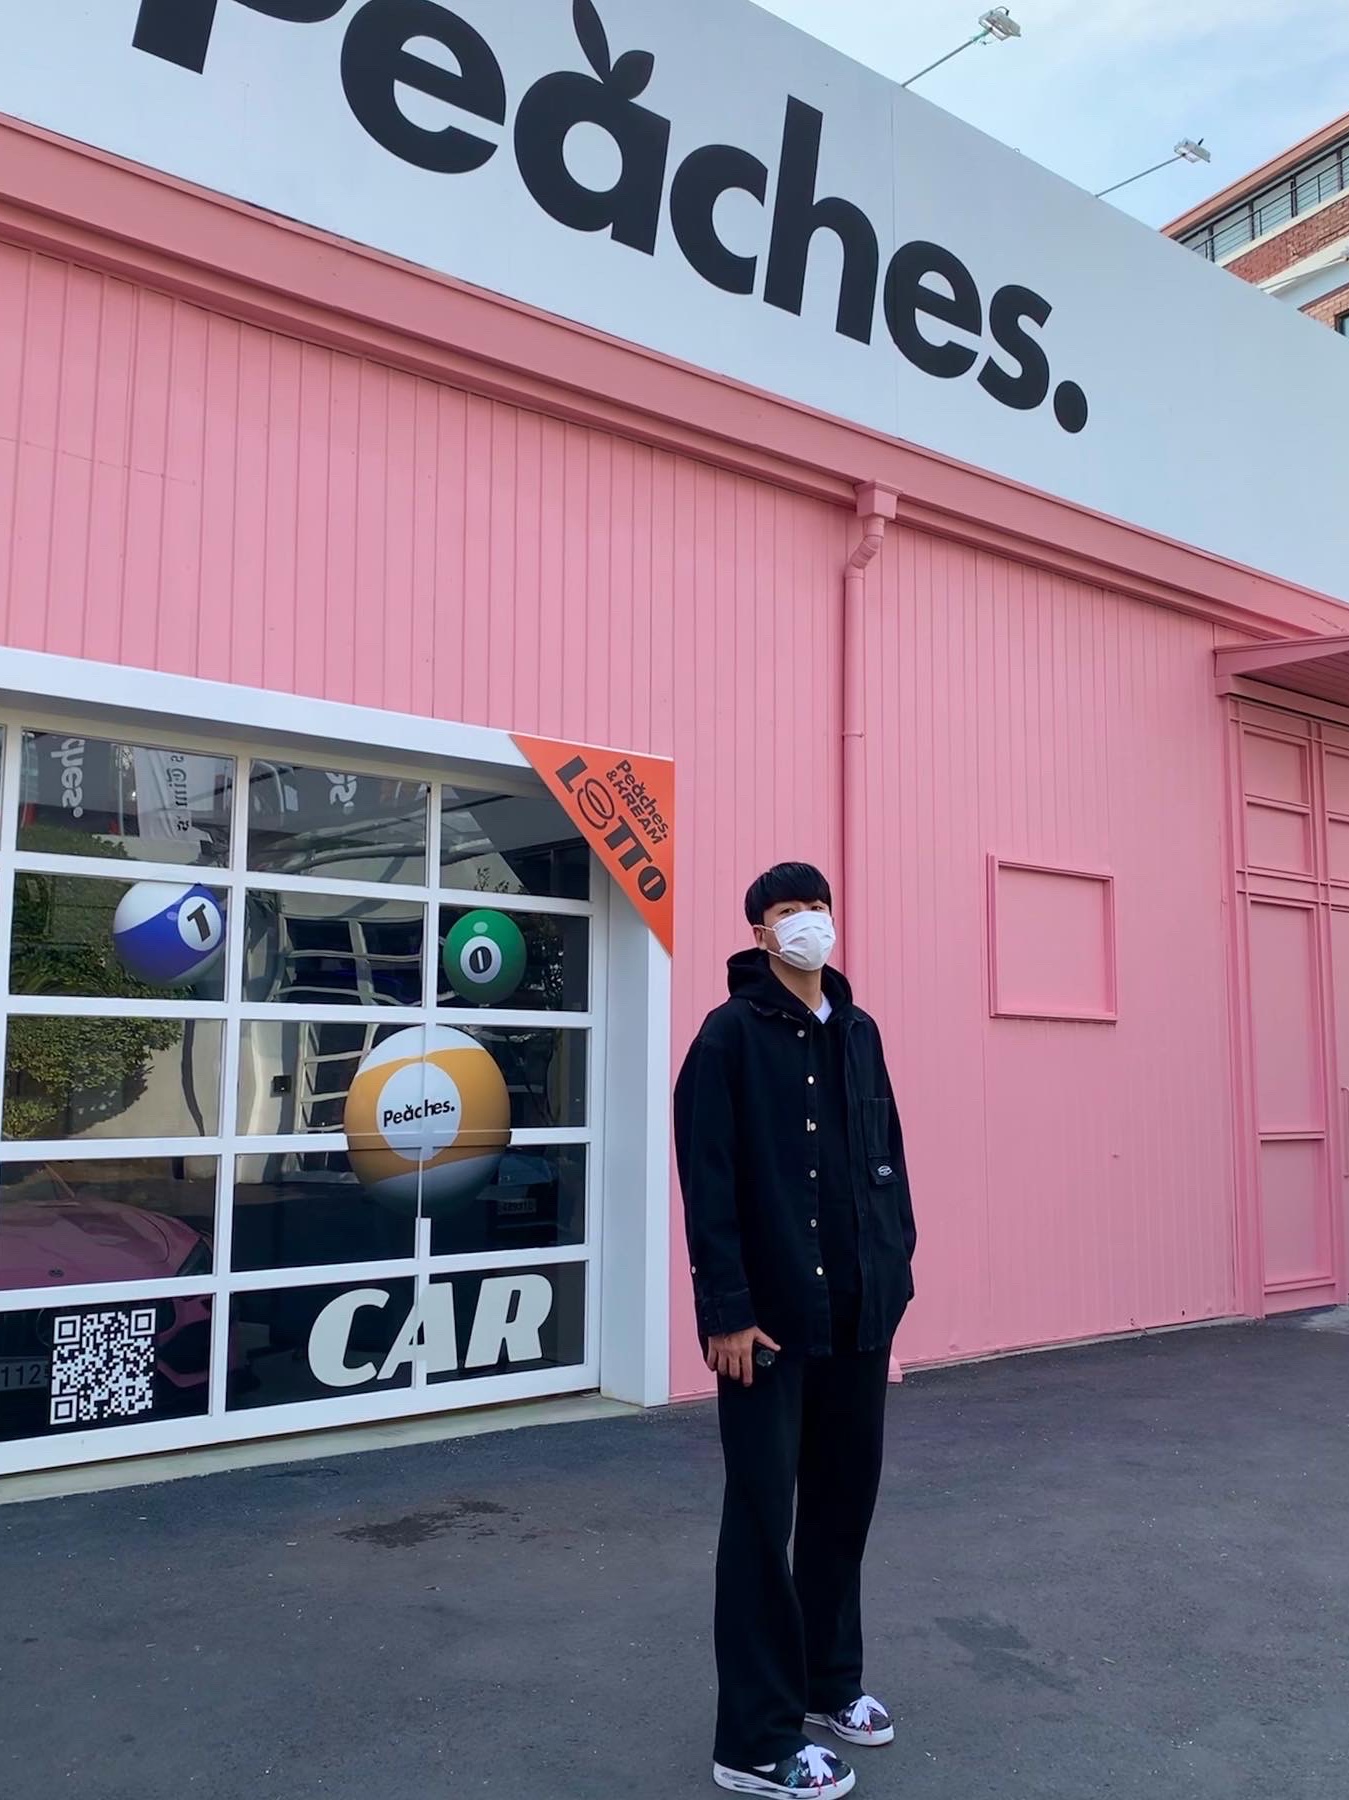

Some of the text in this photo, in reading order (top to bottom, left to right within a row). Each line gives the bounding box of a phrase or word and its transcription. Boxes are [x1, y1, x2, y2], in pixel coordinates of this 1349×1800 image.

[133, 0, 1087, 433] eaches.
[555, 755, 667, 902] LOTTO
[616, 760, 669, 838] Peaches.
[187, 903, 210, 942] T
[383, 1099, 455, 1128] Peaches.
[308, 1274, 553, 1387] CAR
